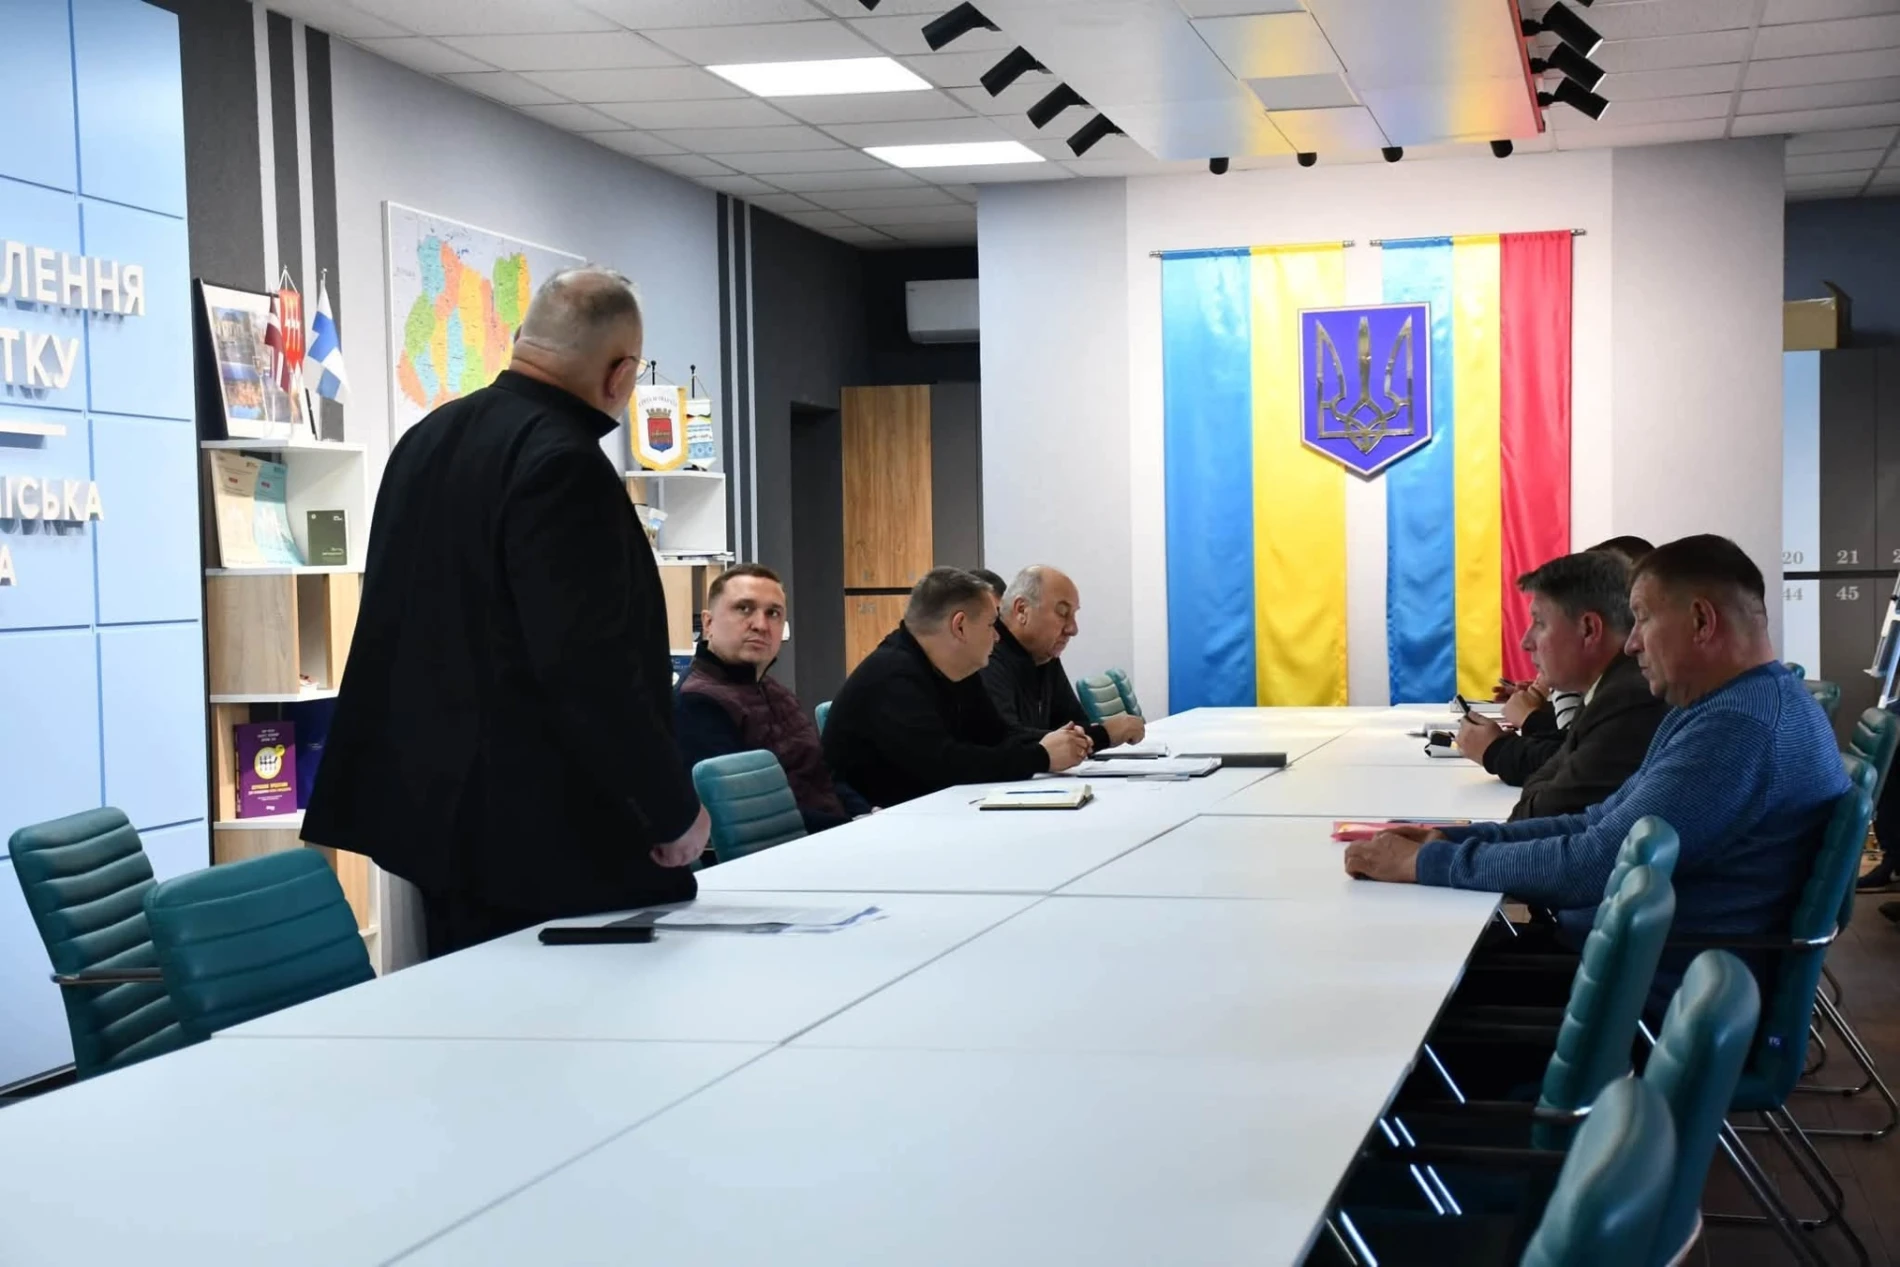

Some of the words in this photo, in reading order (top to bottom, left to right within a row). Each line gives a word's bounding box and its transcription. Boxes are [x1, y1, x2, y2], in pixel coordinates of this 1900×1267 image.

[0, 240, 145, 316] ЛЕННЯ
[0, 327, 79, 389] ТКУ
[1782, 551, 1804, 565] 20
[1836, 549, 1859, 565] 21
[1781, 587, 1803, 601] 44
[1836, 586, 1860, 601] 45
